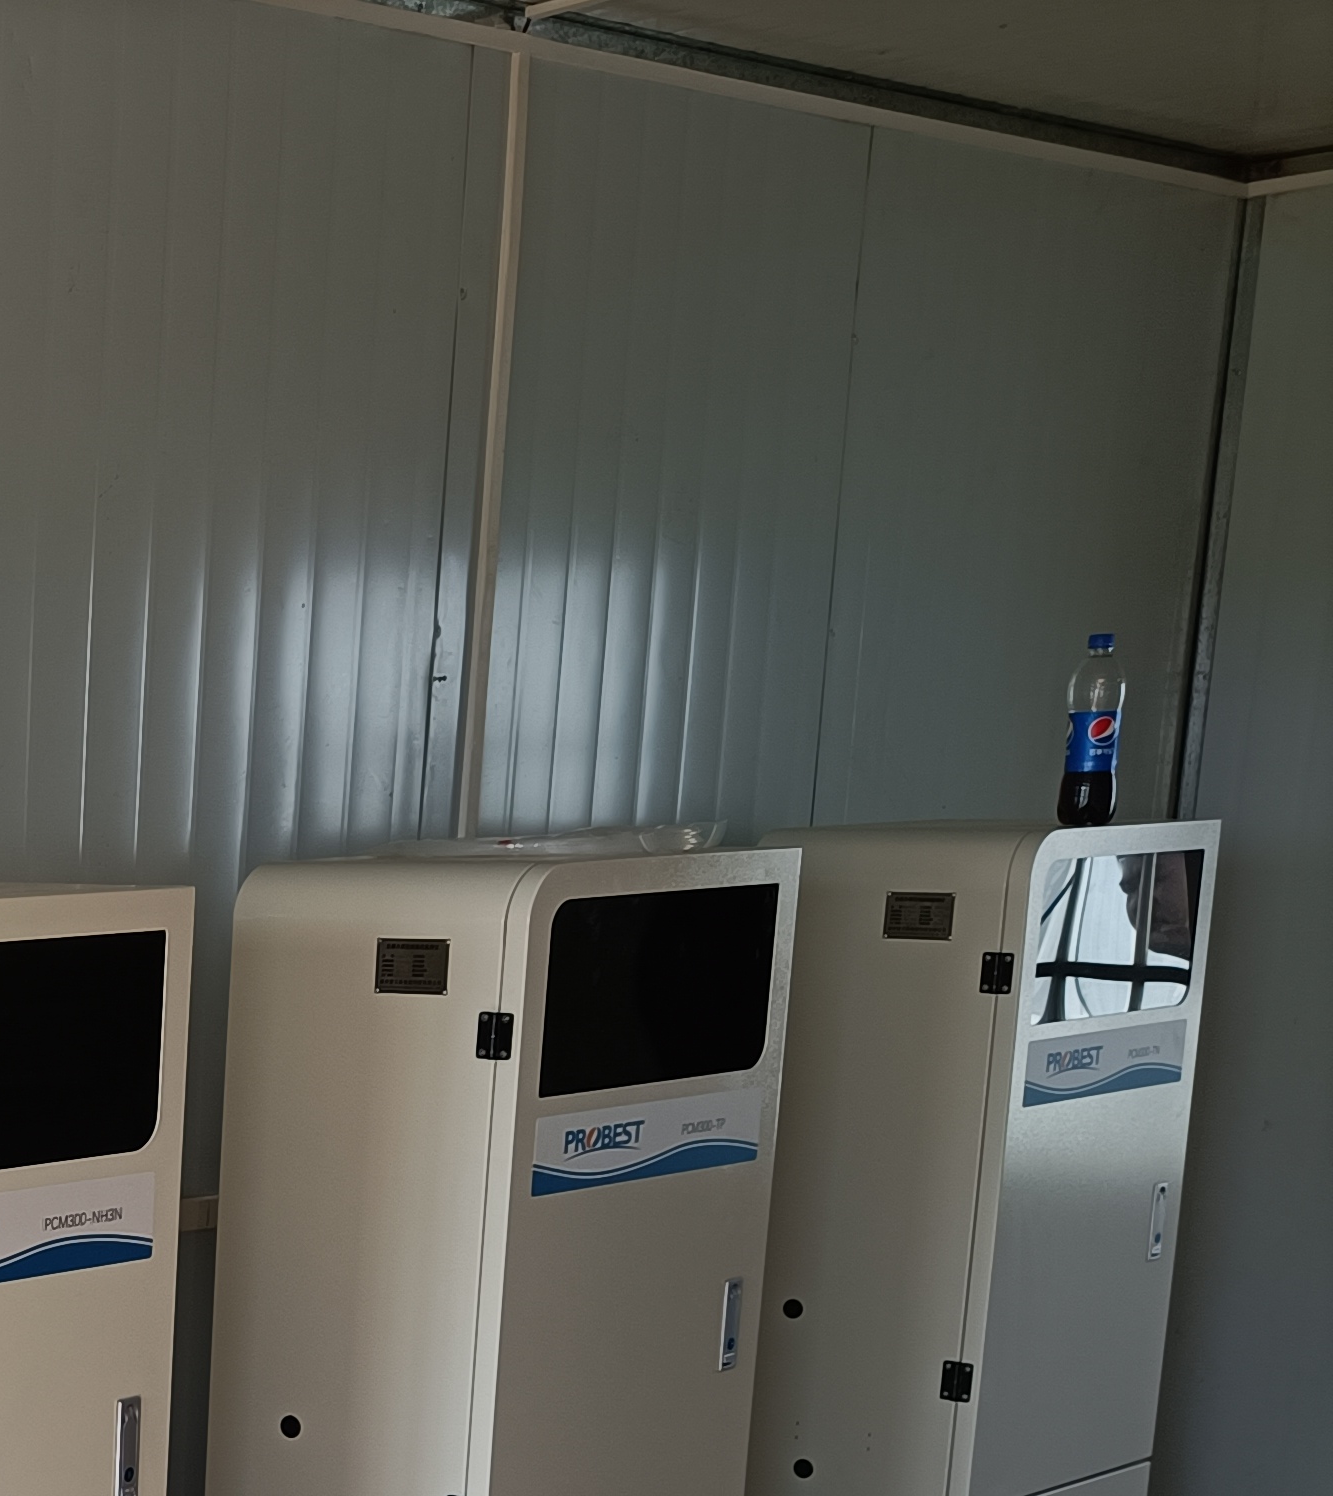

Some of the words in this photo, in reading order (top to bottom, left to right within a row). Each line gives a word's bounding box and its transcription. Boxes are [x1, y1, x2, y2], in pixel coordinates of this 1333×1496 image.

[1046, 1045, 1104, 1073] PROBEST
[563, 1120, 645, 1154] PROBEST
[44, 1207, 123, 1231] PCM300-NH3N
